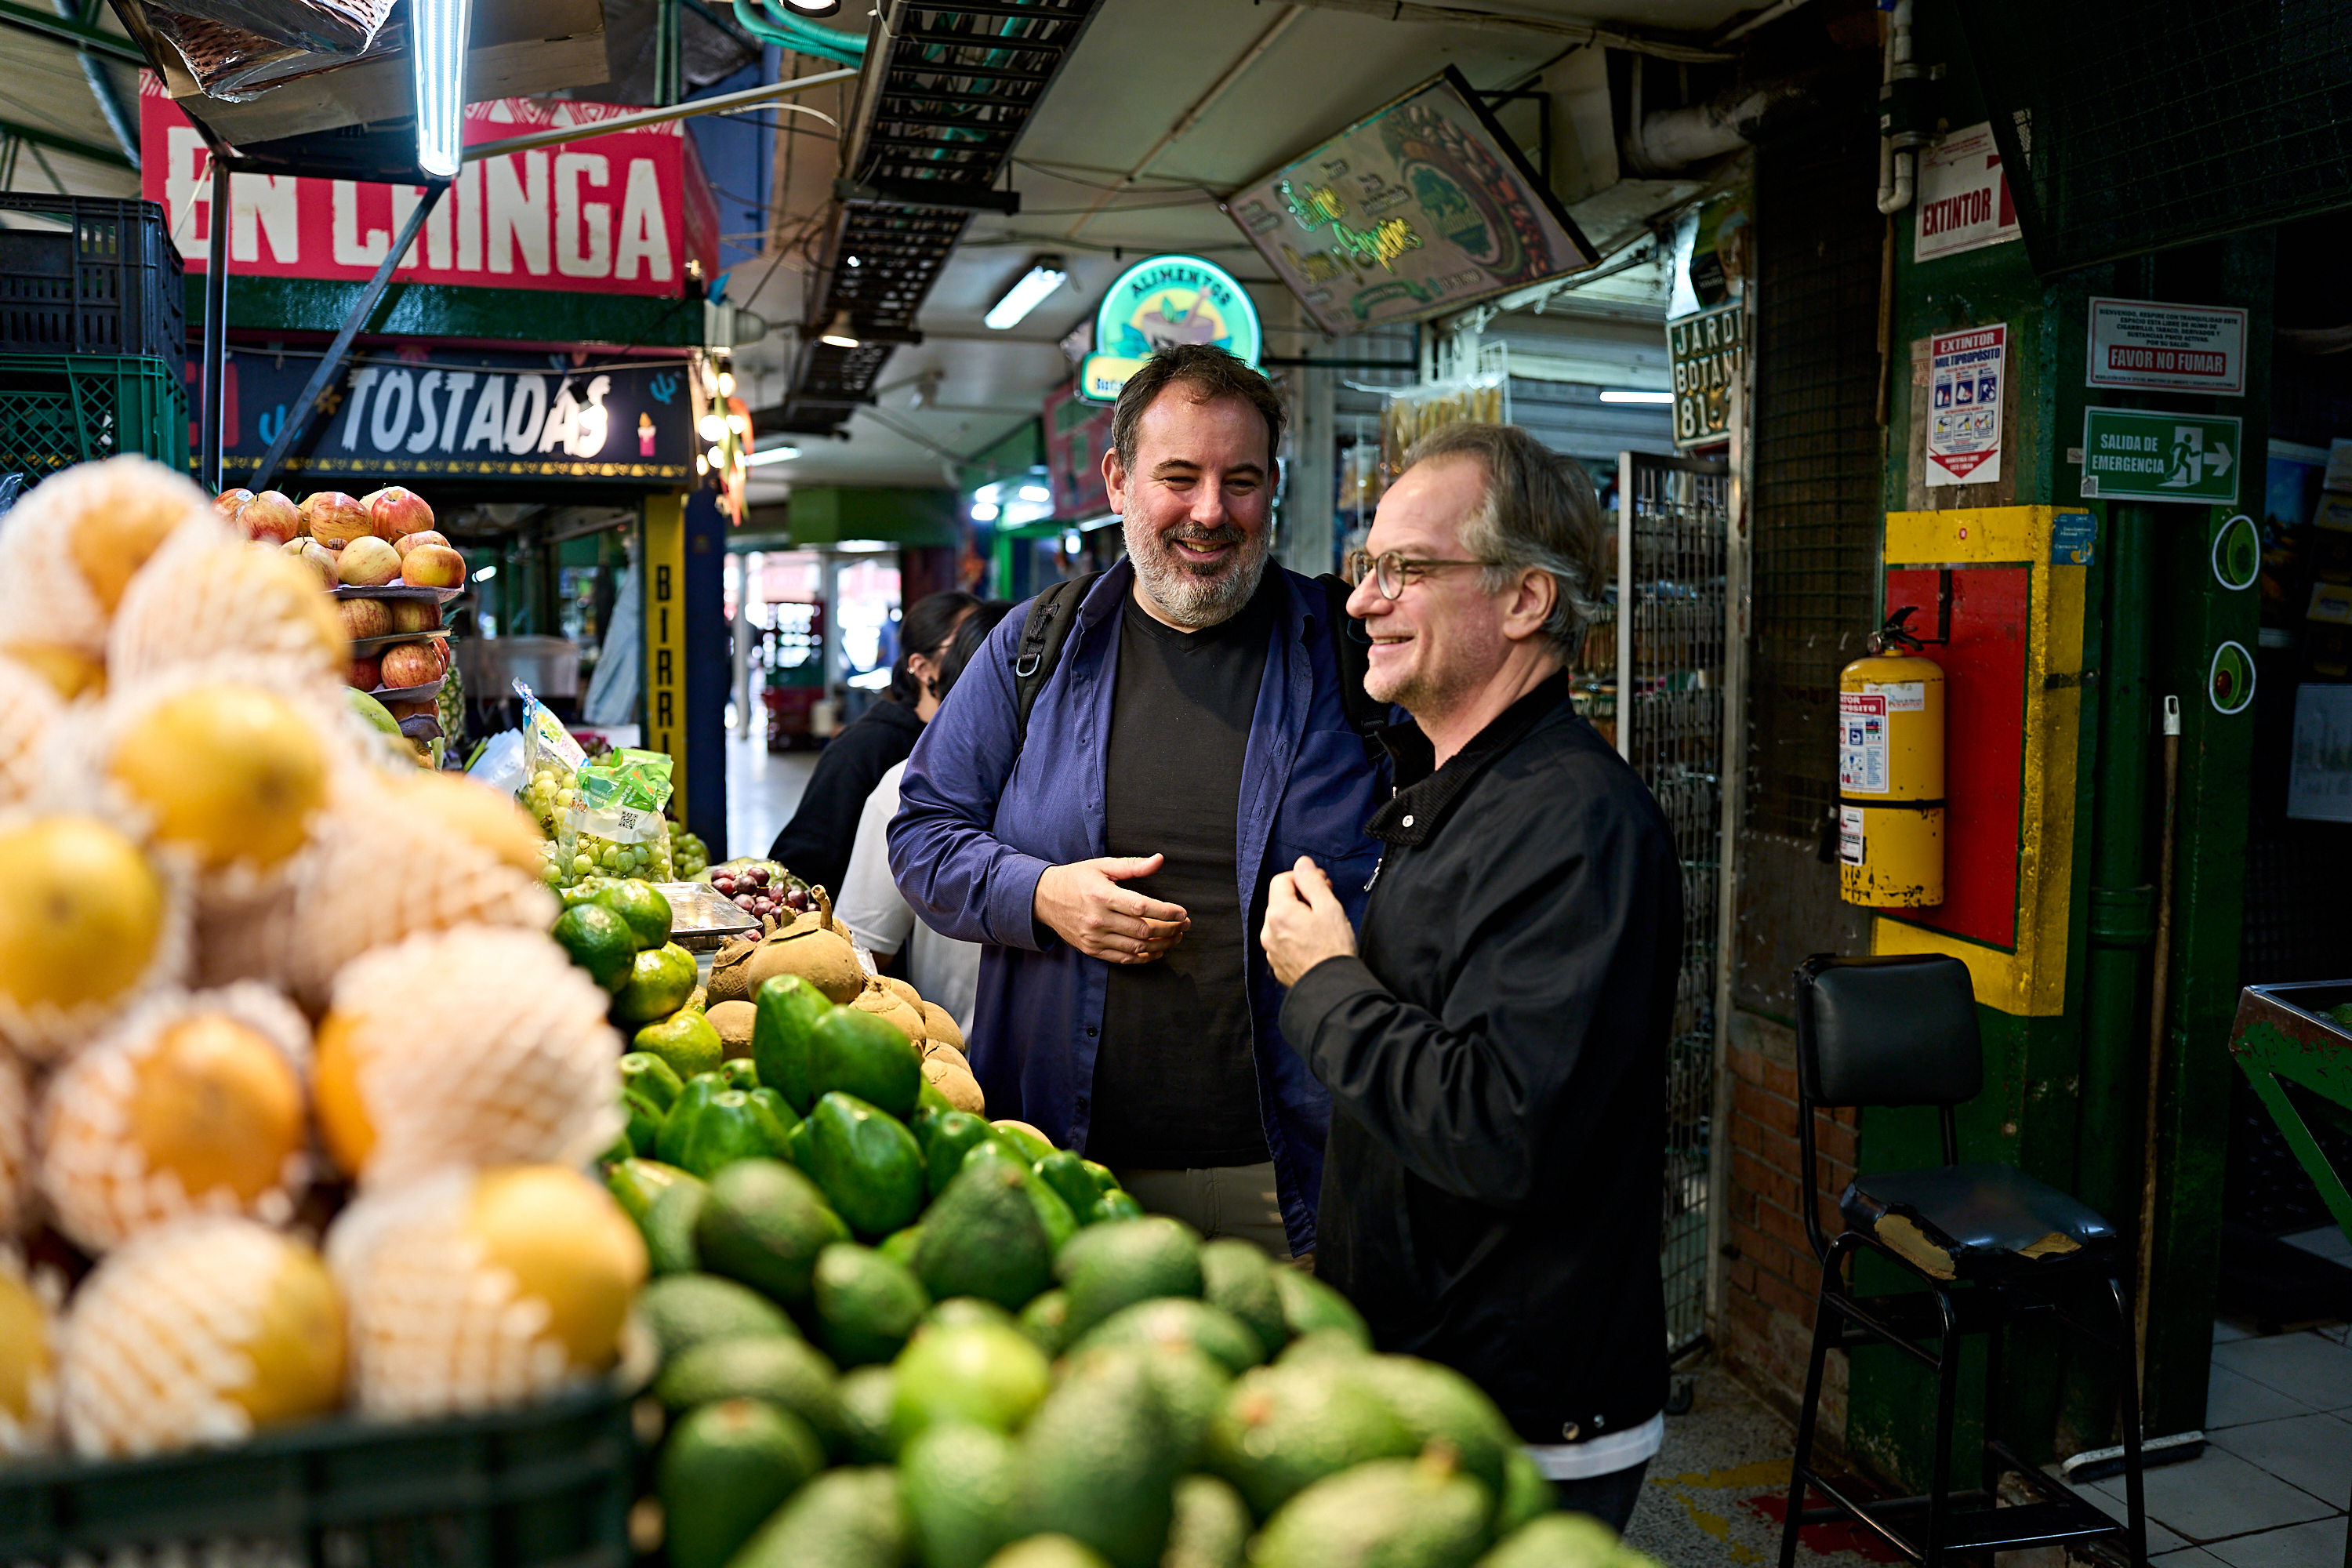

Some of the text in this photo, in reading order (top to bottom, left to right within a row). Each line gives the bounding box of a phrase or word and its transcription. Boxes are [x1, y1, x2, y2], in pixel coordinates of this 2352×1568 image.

[165, 125, 674, 281] EN CHINGA
[1923, 187, 1991, 236] EXTINTOR
[1131, 268, 1230, 305] ALIMENTOS
[2180, 314, 2222, 323] TRANQUILIDAD
[1940, 332, 1995, 354] EXTINTOR
[2111, 348, 2223, 373] FAVOR NO FUMAR
[342, 368, 611, 459] TOSTADAS
[2100, 434, 2158, 452] SALIDA DE
[2092, 455, 2164, 474] EMERGENCIA
